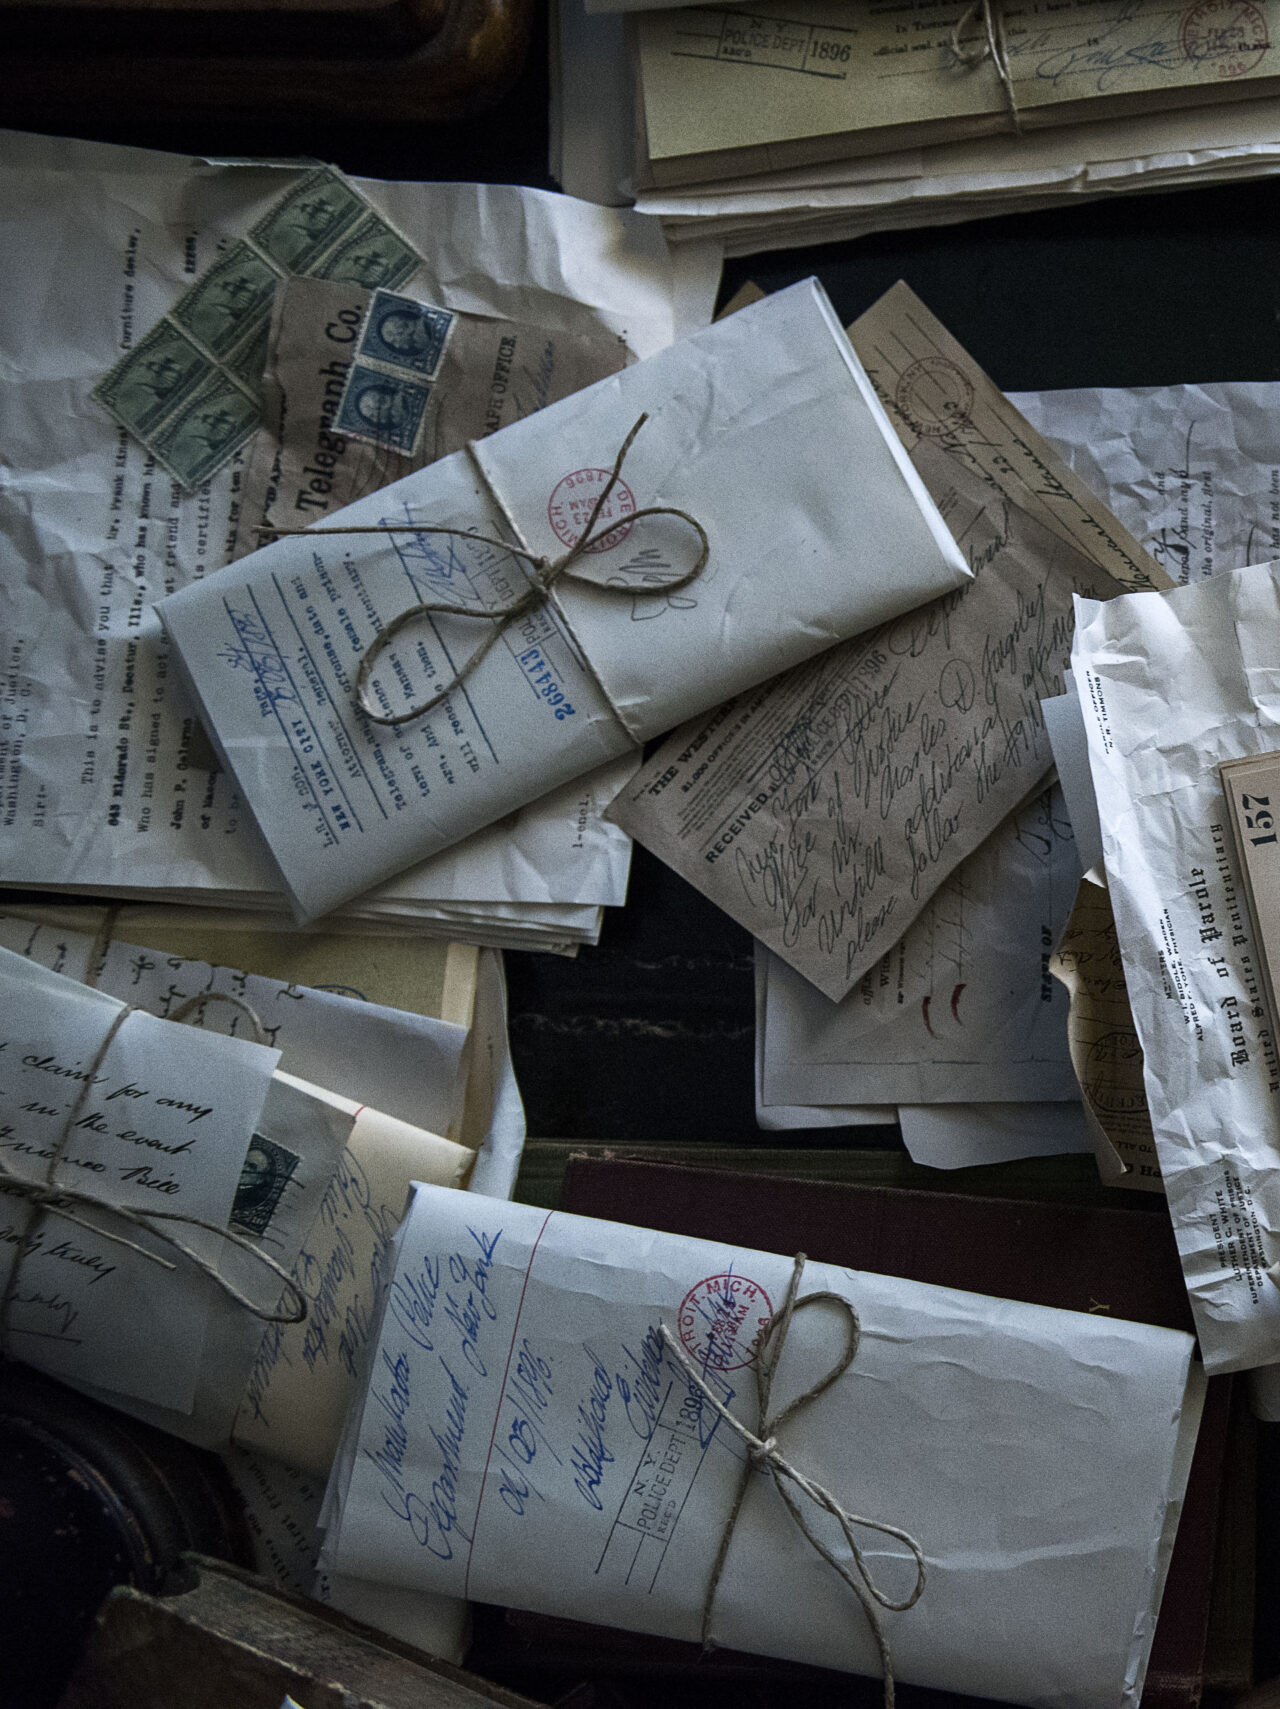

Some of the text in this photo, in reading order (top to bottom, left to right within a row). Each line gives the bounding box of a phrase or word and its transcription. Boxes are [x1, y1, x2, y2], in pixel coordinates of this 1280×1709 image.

[723, 28, 851, 62] POLICE DEPT 1896
[492, 337, 516, 394] OFFICE.
[296, 305, 362, 511] Telegraph Co.
[165, 517, 179, 567] friend
[312, 552, 341, 602] prison-
[486, 568, 515, 598] DEPT
[337, 608, 363, 652] female
[81, 562, 115, 784] This is to advise you that
[389, 654, 413, 699] Kansas
[417, 641, 436, 678] them.
[521, 649, 576, 721] 268443
[292, 720, 351, 830] NEW YORK CITY
[399, 746, 414, 760] of
[648, 766, 678, 795] THE
[170, 800, 184, 830] John
[704, 792, 775, 864] RECEIVED
[1242, 794, 1277, 846] 157
[1210, 823, 1249, 946] Penitentiary
[1188, 868, 1249, 1066] Board of Parole
[1241, 956, 1264, 1018] States
[104, 1082, 150, 1102] for
[116, 1130, 195, 1155] event
[1209, 1214, 1227, 1268] PRESIDENT
[1215, 1191, 1242, 1281] LUTHER C. WHITE
[632, 1451, 661, 1497] N. Y.
[636, 1384, 710, 1531] POLICE DEPT 1896
